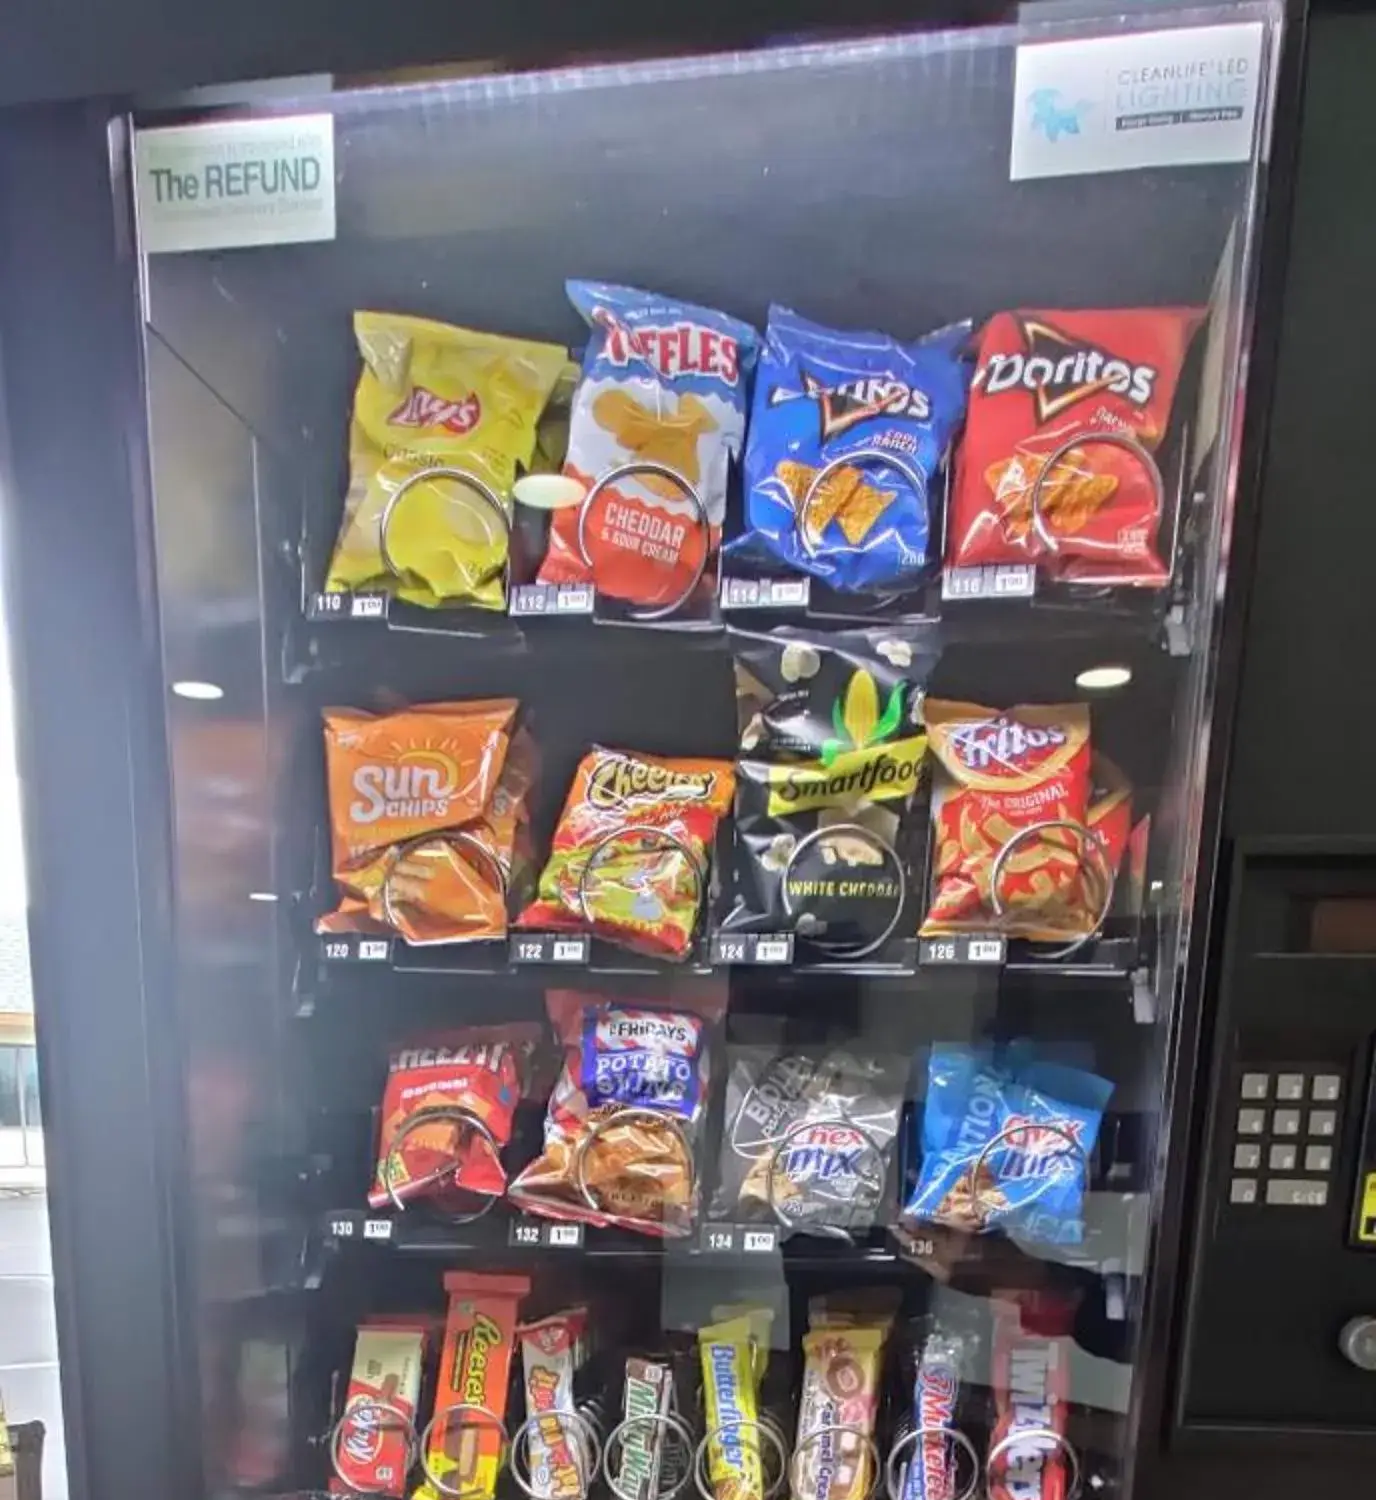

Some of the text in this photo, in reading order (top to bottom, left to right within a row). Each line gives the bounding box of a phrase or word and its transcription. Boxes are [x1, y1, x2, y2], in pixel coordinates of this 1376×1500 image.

[149, 157, 320, 203] The REFUND
[985, 351, 1156, 405] Doritos
[605, 502, 686, 549] CHEDDAR
[641, 541, 680, 566] CREAM
[350, 765, 452, 822] Sun
[1004, 783, 1069, 809] ORIGINAL
[386, 798, 448, 817] CHIPS
[789, 881, 835, 897] WHITE
[326, 944, 349, 957] 120
[519, 944, 542, 958] 122
[720, 944, 744, 959] 124
[596, 1053, 691, 1081] POTATO
[515, 1227, 539, 1242] 132
[709, 1233, 732, 1248] 134
[710, 1344, 743, 1469] Butterfinger
